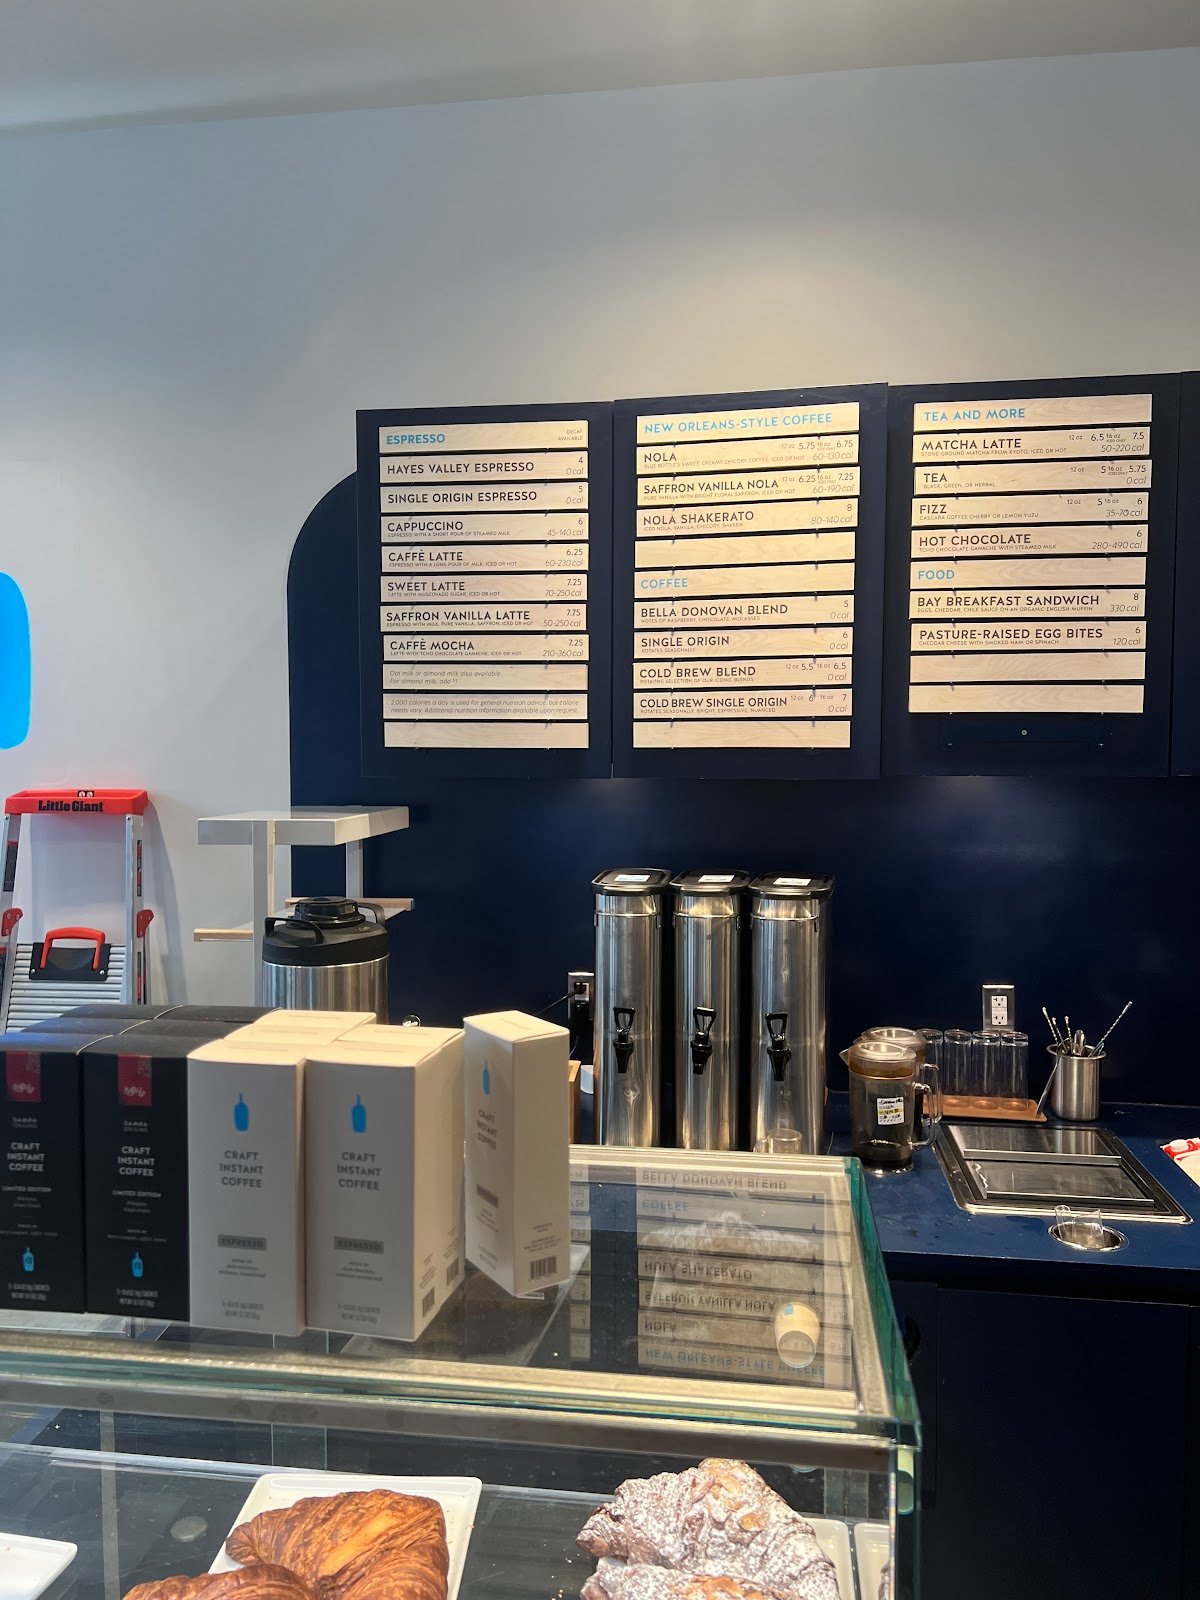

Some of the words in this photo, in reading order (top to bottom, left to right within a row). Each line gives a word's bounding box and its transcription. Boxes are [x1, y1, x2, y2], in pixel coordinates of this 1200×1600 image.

[925, 411, 948, 421] TEA
[954, 410, 981, 420] AND
[986, 408, 1025, 419] MORE
[645, 423, 673, 434] NEW
[678, 417, 777, 432] ORLEANS-STYLE
[783, 413, 832, 426] COFFEE
[387, 434, 445, 444] ESPRESSO
[837, 440, 853, 448] 6.75
[799, 442, 815, 450] 5.75
[922, 440, 977, 450] MATCHA
[984, 439, 1021, 449] LATTE
[1101, 444, 1131, 452] 50-220
[644, 452, 676, 462] NOLA
[388, 464, 424, 474] HAYES
[429, 464, 469, 473] VALLEY
[475, 462, 534, 472] ESPRESSO
[799, 475, 815, 483] 6.25
[839, 473, 854, 481] 7.25
[924, 473, 947, 482] TEA
[644, 483, 694, 494] SAFFRON
[698, 481, 743, 492] VANILLA
[748, 479, 778, 489] NOLA
[388, 494, 428, 503] SINGLE
[433, 493, 472, 502] ORIGIN
[478, 491, 537, 502] ESPRESSO
[920, 504, 946, 514] FIZZ
[1106, 509, 1129, 517] 35-70
[644, 515, 676, 525] NOLA
[681, 511, 754, 524] SHAKERATO
[388, 521, 463, 532] CAPPUCCINO
[920, 537, 946, 546] HOT
[951, 534, 1031, 545] CHOCOLATE
[1092, 541, 1128, 550] 280-490
[389, 549, 424, 562] CAFFÈ
[430, 552, 462, 561] LATTE
[919, 570, 954, 580] FOOD
[388, 582, 427, 591] SWEET
[432, 582, 465, 591] LATTE
[641, 578, 687, 589] COFFEE
[918, 597, 941, 606] BAY
[947, 595, 1021, 606] BREAKFAST
[1027, 596, 1099, 605] SANDWICH
[387, 612, 439, 621] SAFFRON
[444, 611, 491, 620] VANILLA
[497, 611, 530, 620] LATTE
[642, 608, 676, 617] BELLA
[682, 606, 742, 617] DONOVAN
[748, 605, 788, 615] BLEND
[920, 629, 1030, 639] PASTURE-RAISED
[1036, 629, 1061, 638] EGG
[1067, 629, 1102, 638] BITES
[391, 638, 426, 650] CAFFÈ
[431, 641, 474, 650] MOCHA
[641, 638, 683, 648] SINGLE
[687, 636, 729, 646] ORIGIN
[801, 663, 814, 671] 5.5
[640, 669, 672, 678] COLD
[677, 668, 711, 677] BREW
[717, 667, 755, 676] BLEND
[640, 699, 668, 708] COLD
[672, 699, 704, 708] BREW
[707, 698, 744, 707] SINGLE
[748, 698, 787, 707] ORIGIN
[808, 694, 814, 702] 6
[38, 800, 70, 812] Little
[72, 801, 103, 812] Giant
[11, 1142, 40, 1152] CRAFT
[122, 1146, 150, 1155] CRAFT
[7, 1152, 45, 1162] INSTANT
[224, 1150, 258, 1161] CRAFT
[342, 1152, 376, 1163] CRAFT
[118, 1156, 156, 1166] INSTANT
[8, 1162, 44, 1172] COFFEE
[119, 1167, 154, 1176] COFFEE
[220, 1164, 264, 1174] INSTANT
[337, 1165, 382, 1176] INSTANT
[221, 1177, 262, 1188] COFFEE
[338, 1179, 380, 1190] COFFEE
